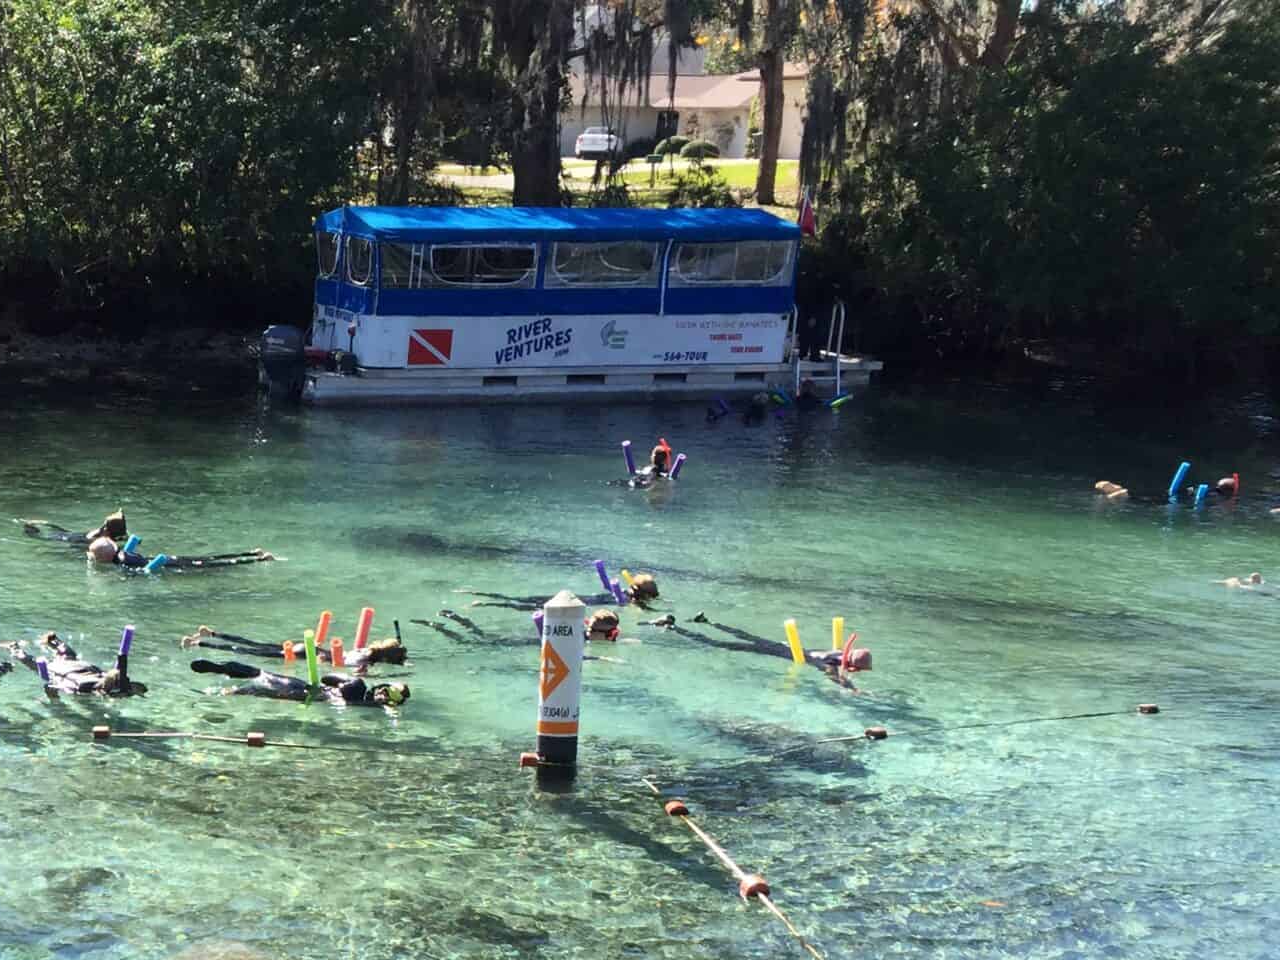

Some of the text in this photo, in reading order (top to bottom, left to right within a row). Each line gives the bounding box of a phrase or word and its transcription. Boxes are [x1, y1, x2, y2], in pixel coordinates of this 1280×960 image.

[506, 318, 552, 345] RIVER
[495, 327, 573, 365] VENTURES
[552, 625, 573, 636] AREA
